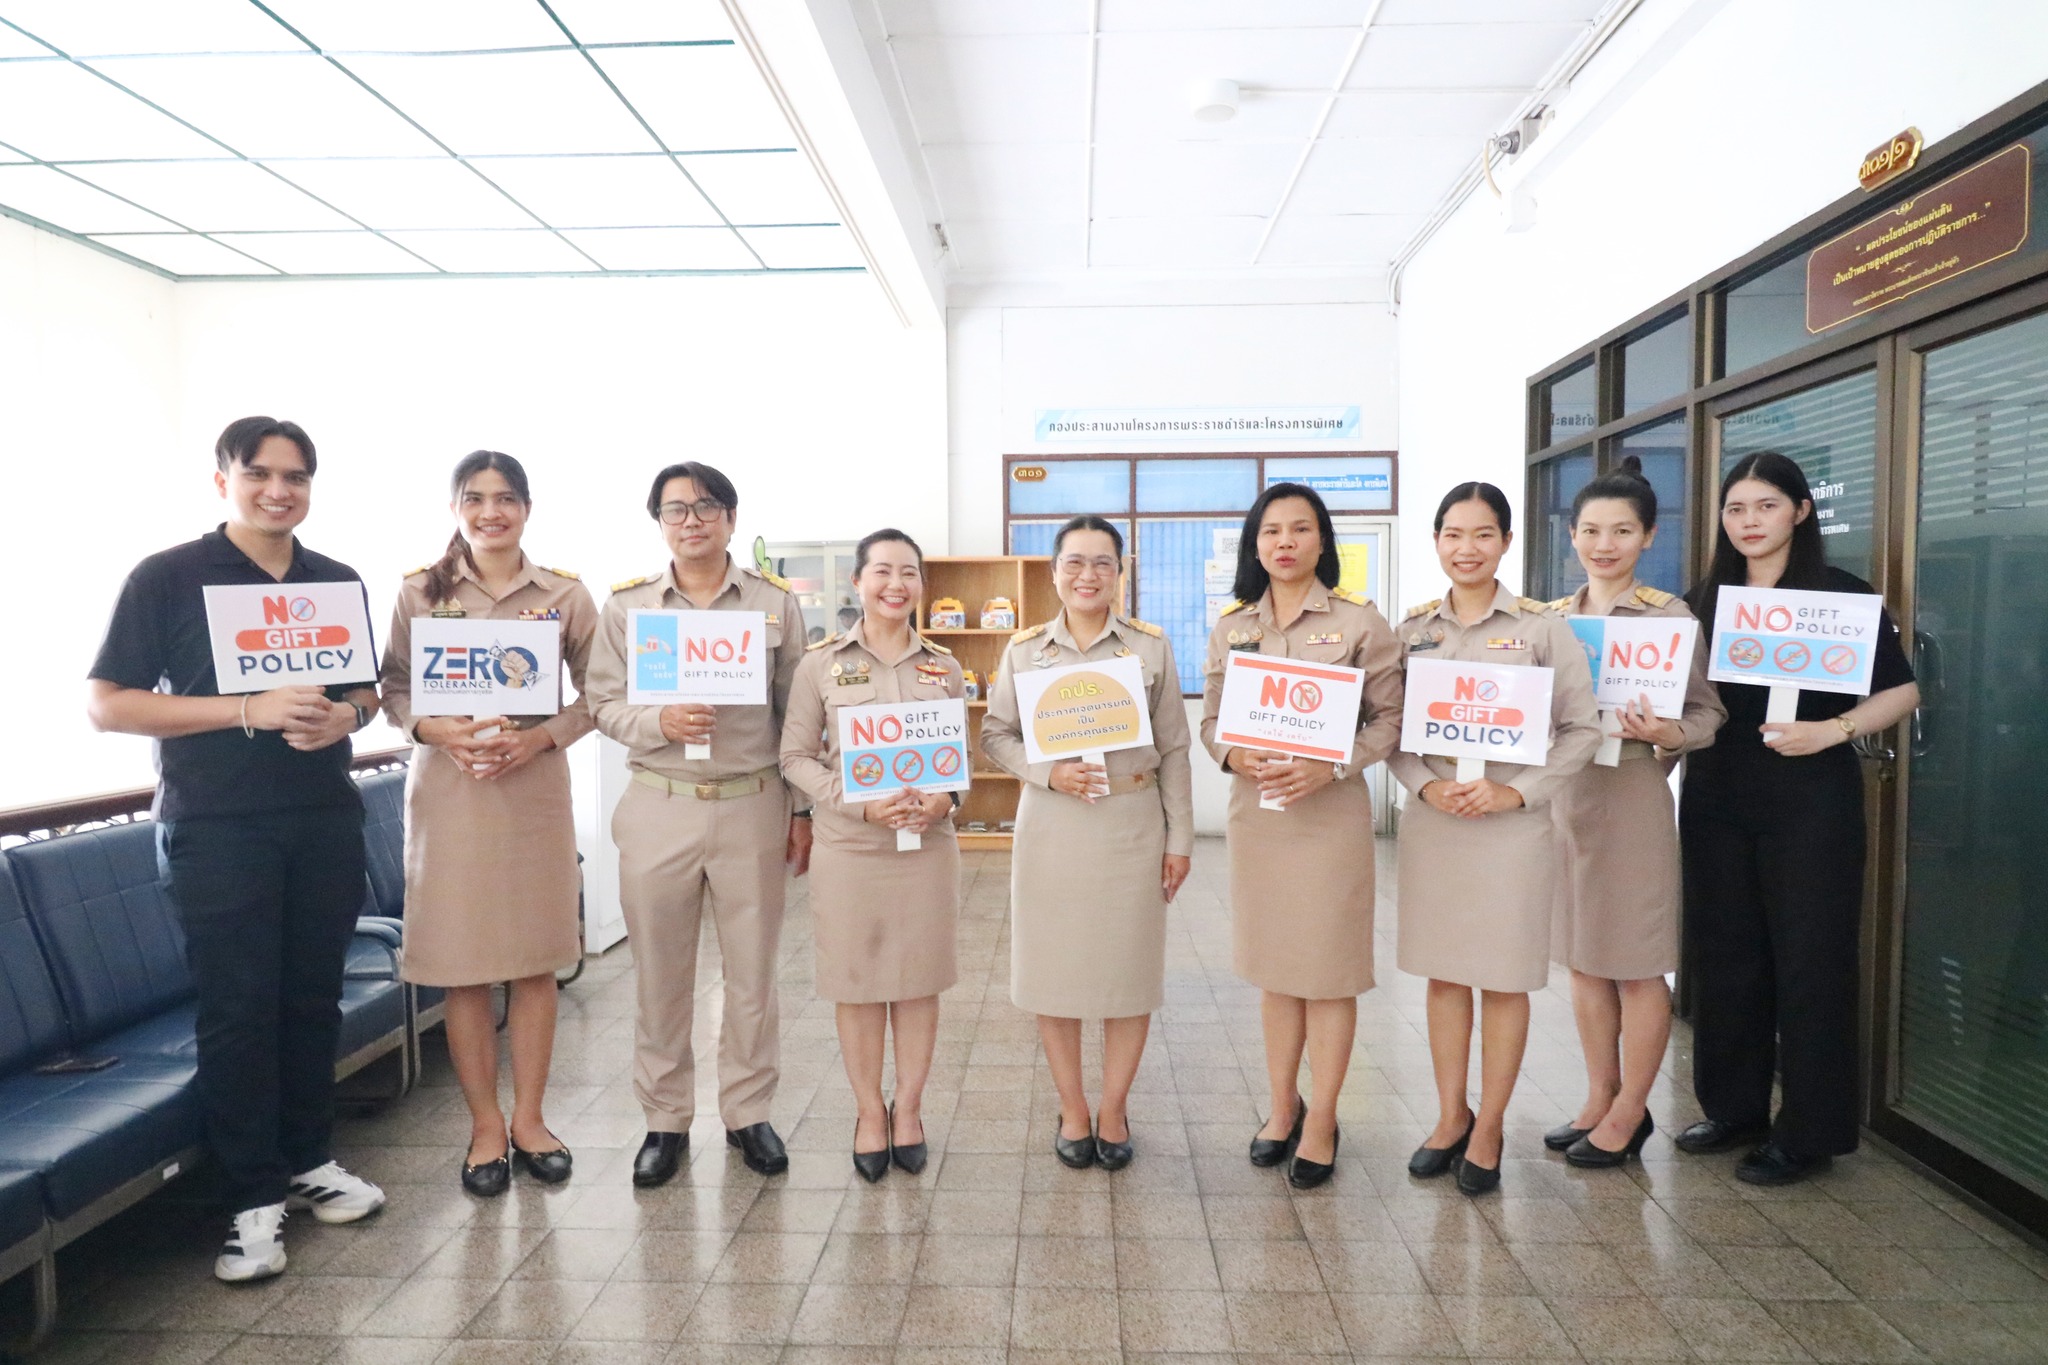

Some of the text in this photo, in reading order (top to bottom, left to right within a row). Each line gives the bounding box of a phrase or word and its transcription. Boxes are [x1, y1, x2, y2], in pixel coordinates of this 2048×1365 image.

[1049, 417, 1344, 432] กองประสานงานโครงการพระราชดำริและโครงการพิเศษ
[1734, 602, 1793, 632] NO
[1797, 607, 1840, 620] GIFT
[265, 628, 322, 649] GIFT
[1795, 622, 1864, 637] POLICY
[685, 630, 751, 664] NO!
[1609, 632, 1681, 672] NO!
[237, 649, 353, 675] POLICY
[423, 646, 538, 689] ZERO
[423, 680, 493, 689] TOLERANCE
[684, 671, 753, 679] GIFT POLICY
[1605, 677, 1678, 688] GIFT POLICY
[1059, 680, 1104, 700] กปร.
[905, 711, 940, 724] GIFT
[1037, 697, 1131, 719] ประกาศเจตนารมณ์
[1450, 705, 1500, 723] GIFT
[1077, 715, 1095, 725] เป็น
[1249, 711, 1326, 731] GIFT POLICY
[851, 714, 903, 746] NO
[905, 725, 961, 740] POLICY
[1048, 723, 1129, 742] องค์กรคุณธรรม
[1425, 721, 1524, 747] POLICY
